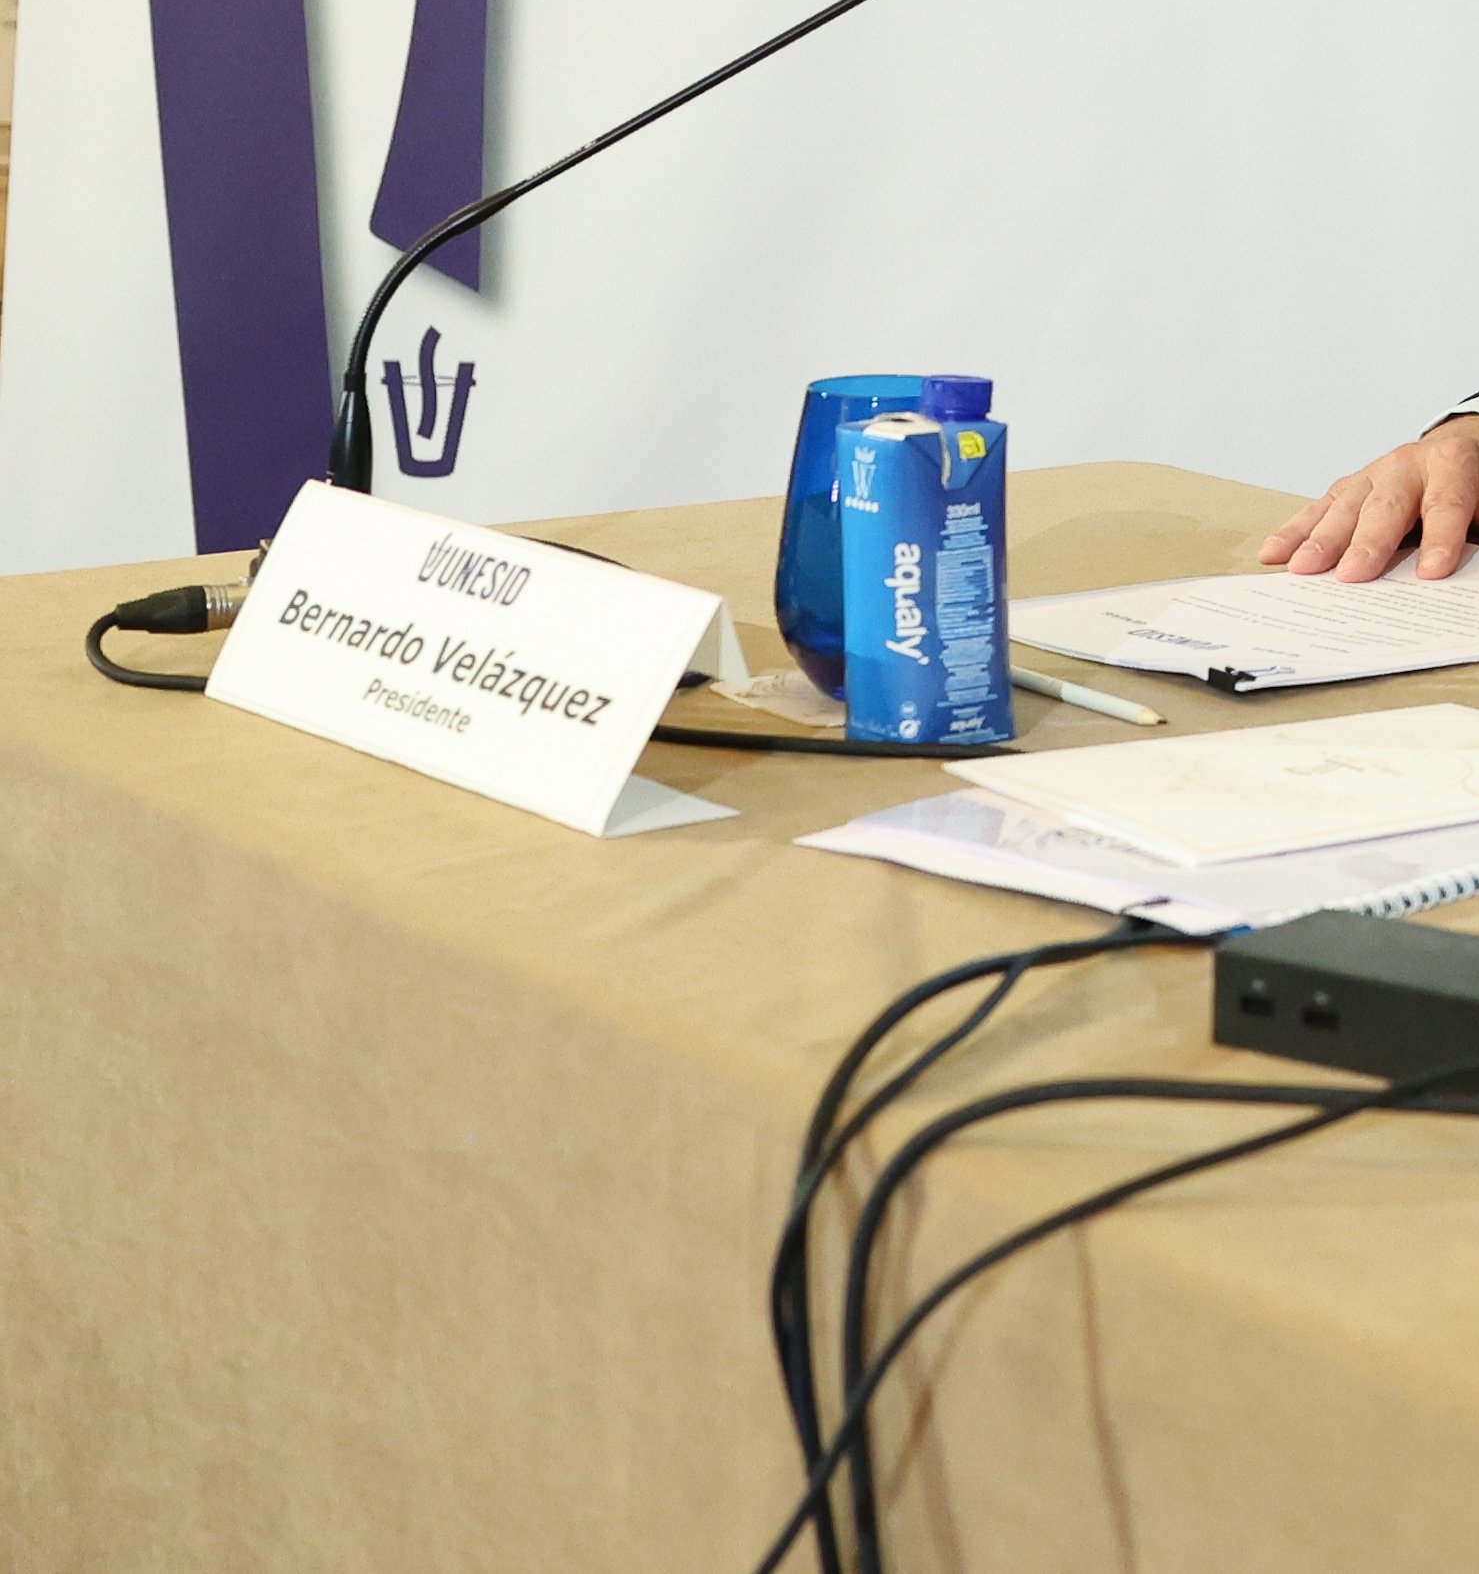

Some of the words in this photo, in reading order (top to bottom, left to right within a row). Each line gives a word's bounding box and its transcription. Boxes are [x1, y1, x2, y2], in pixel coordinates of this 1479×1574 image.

[437, 539, 532, 606] UNESID
[884, 542, 930, 662] aqualy
[279, 589, 425, 665] Bernardo
[432, 636, 613, 726] Velázquez
[363, 678, 472, 734] Presidente
